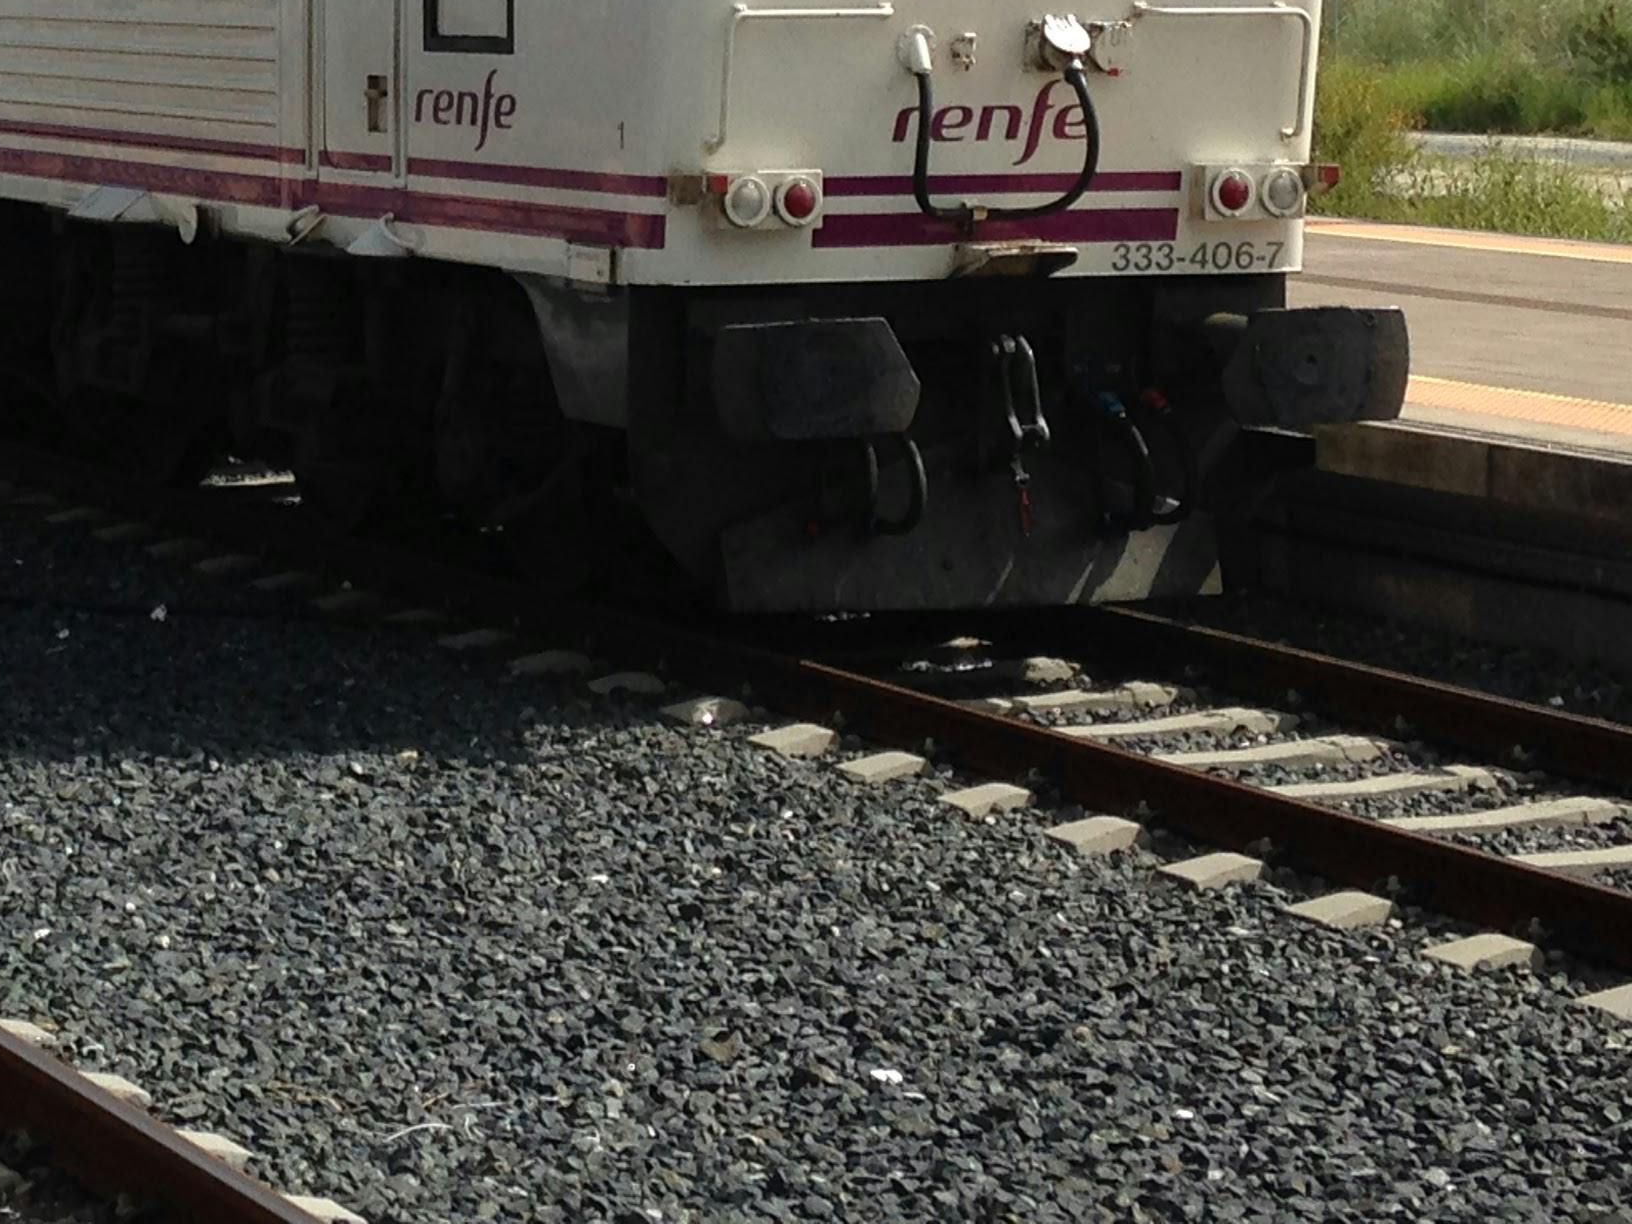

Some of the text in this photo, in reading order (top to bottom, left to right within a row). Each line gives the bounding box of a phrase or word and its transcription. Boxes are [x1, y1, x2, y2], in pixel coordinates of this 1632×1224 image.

[414, 68, 516, 152] renfe
[892, 79, 1088, 166] renfe
[1111, 241, 1284, 272] 333-406-7
